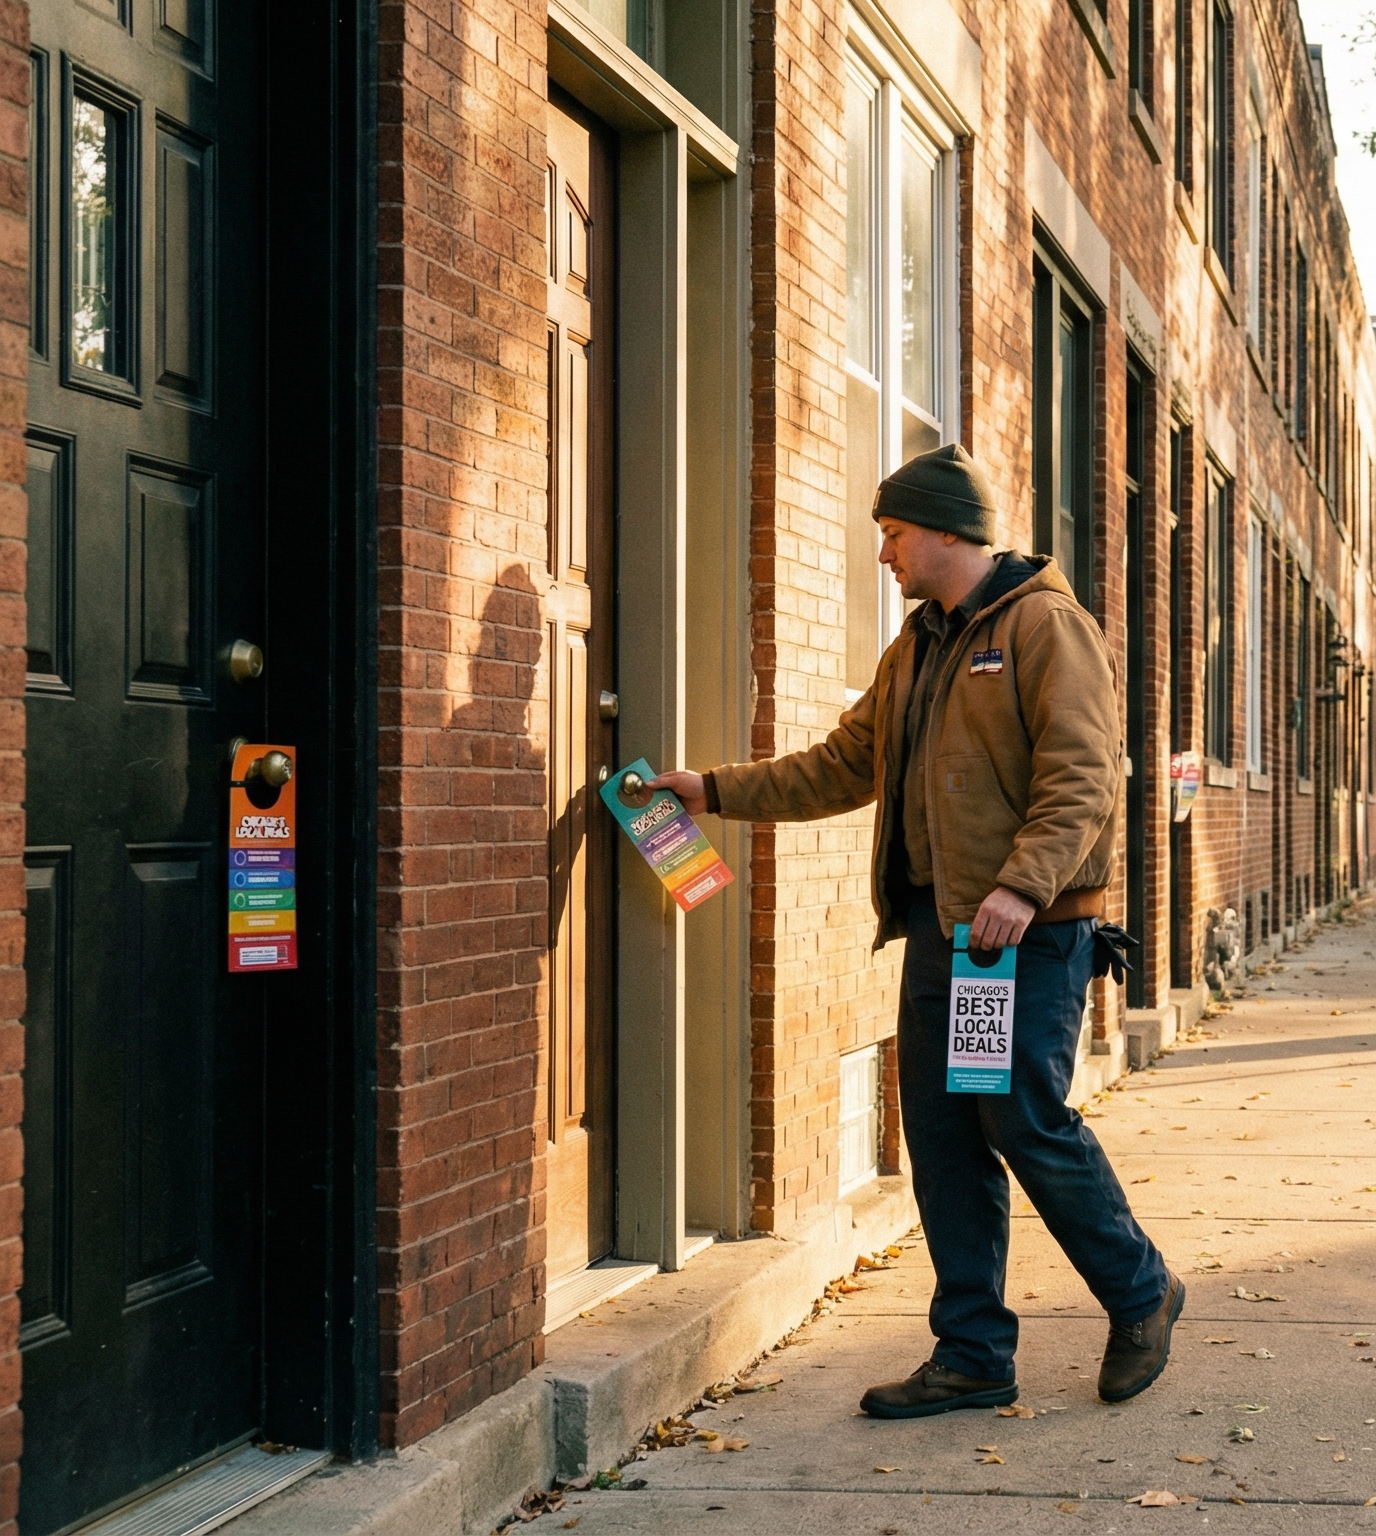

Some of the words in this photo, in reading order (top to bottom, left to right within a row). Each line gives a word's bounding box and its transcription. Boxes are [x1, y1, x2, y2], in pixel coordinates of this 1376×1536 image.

[957, 985, 1009, 996] CHICAGO'S
[956, 997, 1009, 1017] BEST
[955, 1019, 1007, 1035] LOCAL
[953, 1037, 1007, 1053] DEALS
